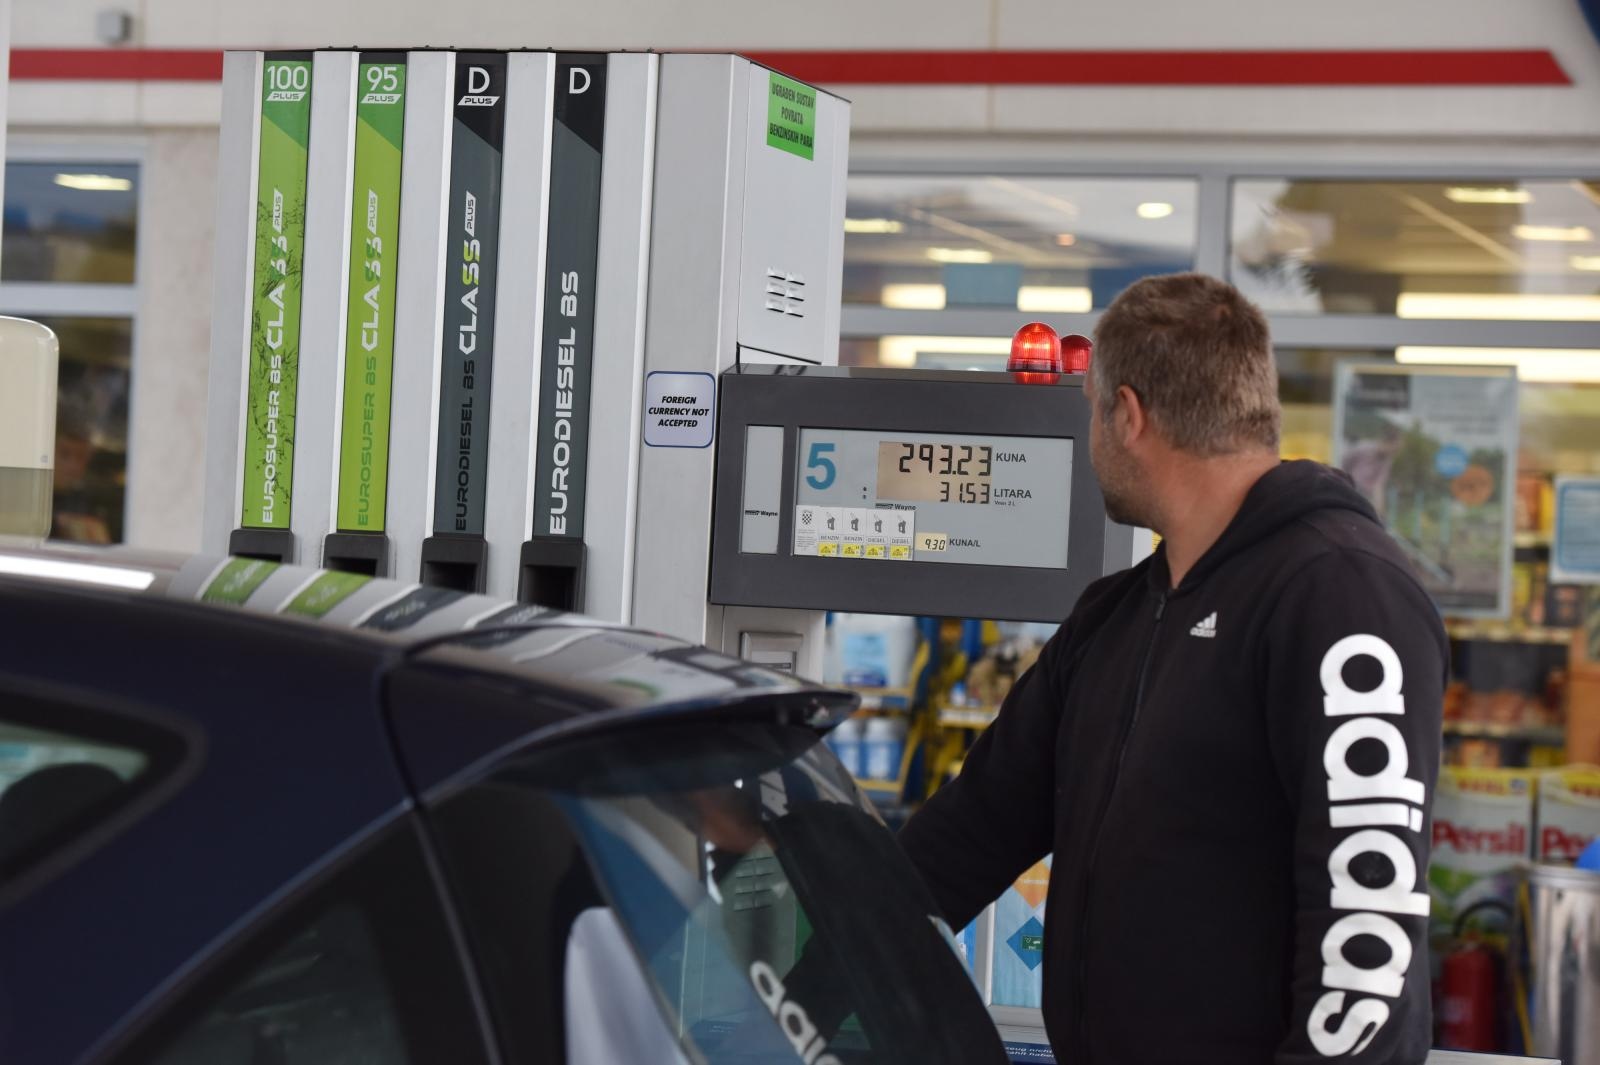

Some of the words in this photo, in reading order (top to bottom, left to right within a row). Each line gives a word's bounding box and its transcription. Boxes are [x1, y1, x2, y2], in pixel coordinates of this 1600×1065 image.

[267, 65, 309, 91] 100
[366, 67, 398, 92] 95
[469, 67, 490, 94] D
[569, 68, 591, 95] D
[273, 93, 300, 101] PLUS
[367, 94, 395, 103] PLUS
[464, 97, 494, 106] PLUS
[781, 106, 804, 125] POVRATA
[273, 196, 283, 227] PLUS
[369, 196, 378, 227] PLUS
[465, 197, 475, 231] PLUS
[266, 236, 288, 350] CLASS
[361, 236, 383, 352] CLASS
[458, 239, 481, 356] CLASS
[560, 271, 579, 318] BS
[648, 407, 691, 416] CURRENCY
[691, 408, 710, 417] NOT
[661, 395, 697, 405] FOREIGN
[549, 327, 577, 535] EURODIESEL
[658, 418, 698, 428] ACCEPTED
[261, 388, 281, 524] EUROSUPER
[358, 392, 376, 527] EUROSUPER
[455, 396, 474, 531] EURODIESEL
[805, 442, 837, 490] 5
[899, 443, 992, 477] 293.23
[996, 452, 1027, 463] KUNA
[940, 481, 990, 504] 31.53
[993, 488, 1032, 499] LITARA
[894, 503, 917, 511] Wayne
[924, 538, 946, 551] 9.30
[949, 537, 982, 548] KUNA/L
[1307, 633, 1431, 1057] adidas
[1432, 818, 1526, 855] Persil
